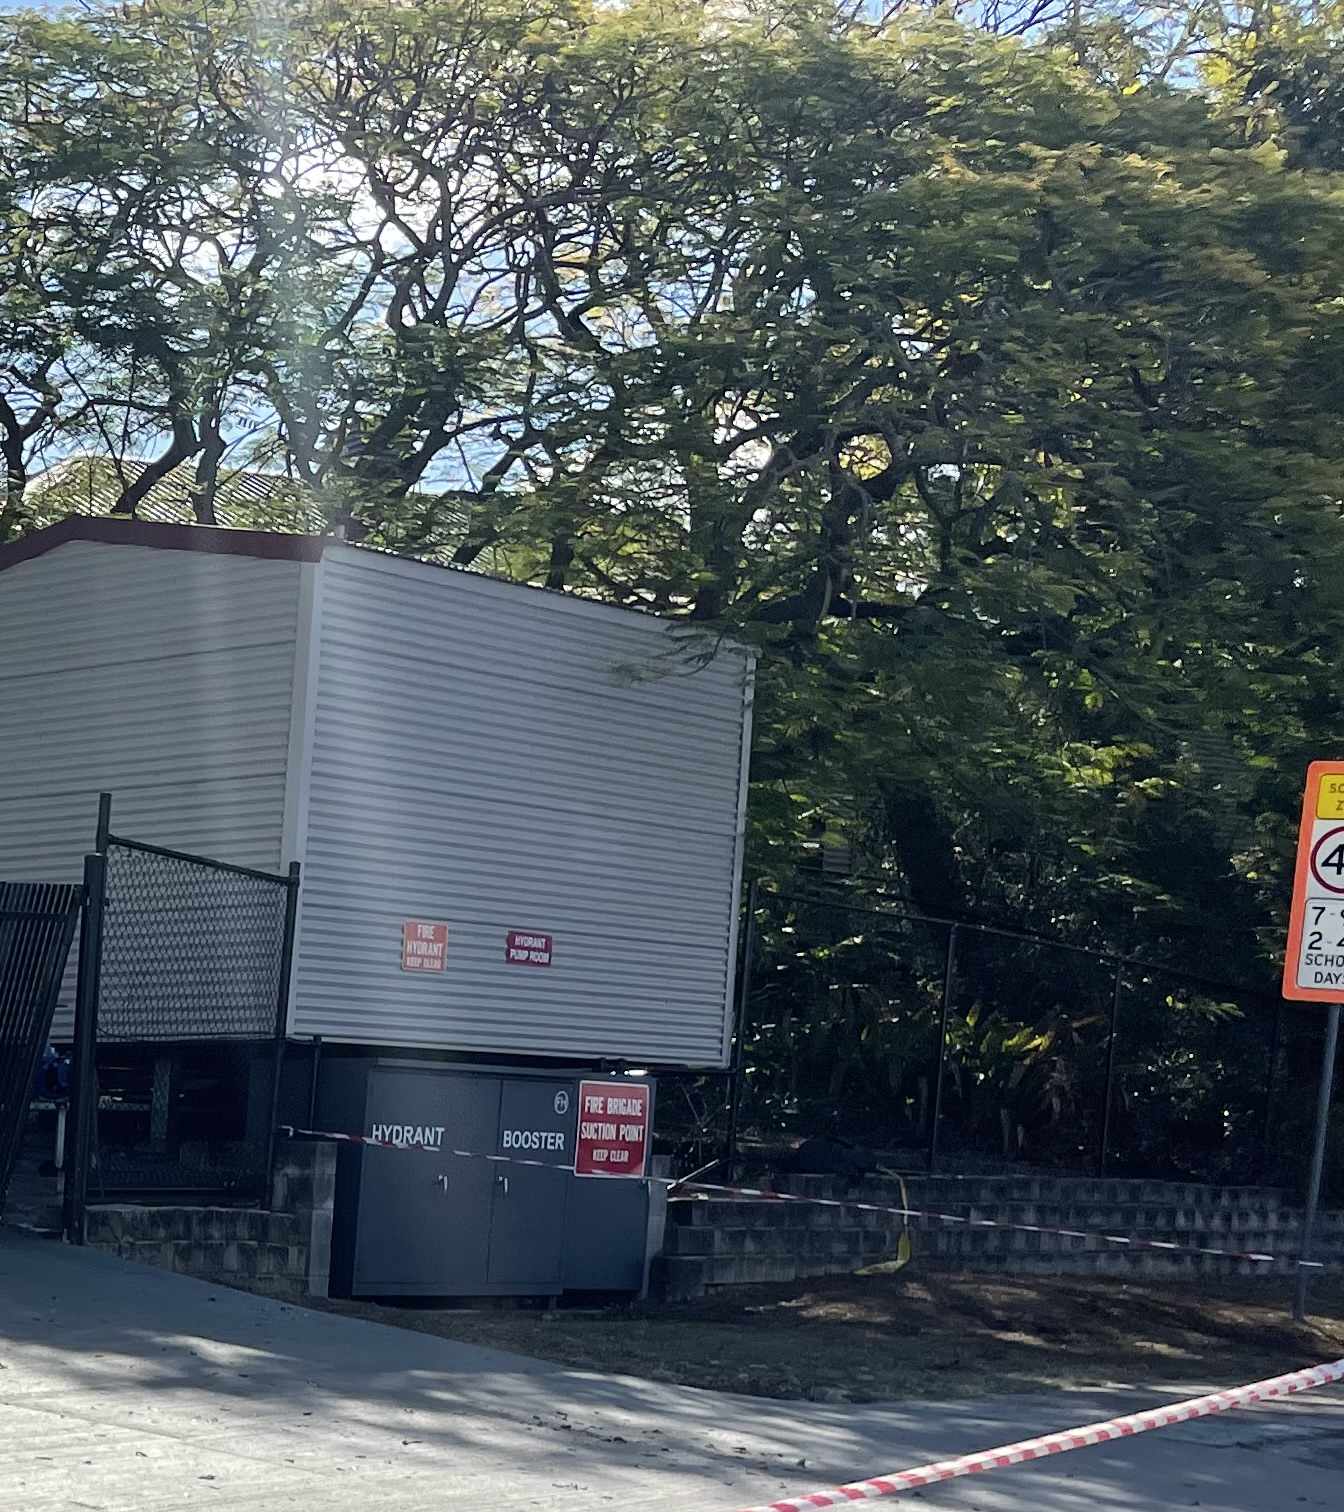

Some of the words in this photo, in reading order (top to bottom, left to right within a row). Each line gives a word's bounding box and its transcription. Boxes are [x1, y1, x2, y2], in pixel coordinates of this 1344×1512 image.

[417, 924, 435, 940] FIRE
[406, 940, 444, 958] HYDRANT
[514, 935, 547, 949] HYDRANT
[406, 956, 422, 968] KEEP
[510, 948, 529, 961] PUMP
[529, 950, 550, 964] ROOM
[584, 1095, 605, 1115] FIRE
[607, 1097, 643, 1117] BRIGADE
[372, 1123, 446, 1147] HYDRANT
[502, 1130, 565, 1150] BOOSTER
[580, 1121, 617, 1141] SUCTION
[618, 1123, 644, 1142] POINT
[593, 1149, 609, 1162] KEEP
[609, 1150, 630, 1163] CLEAR
